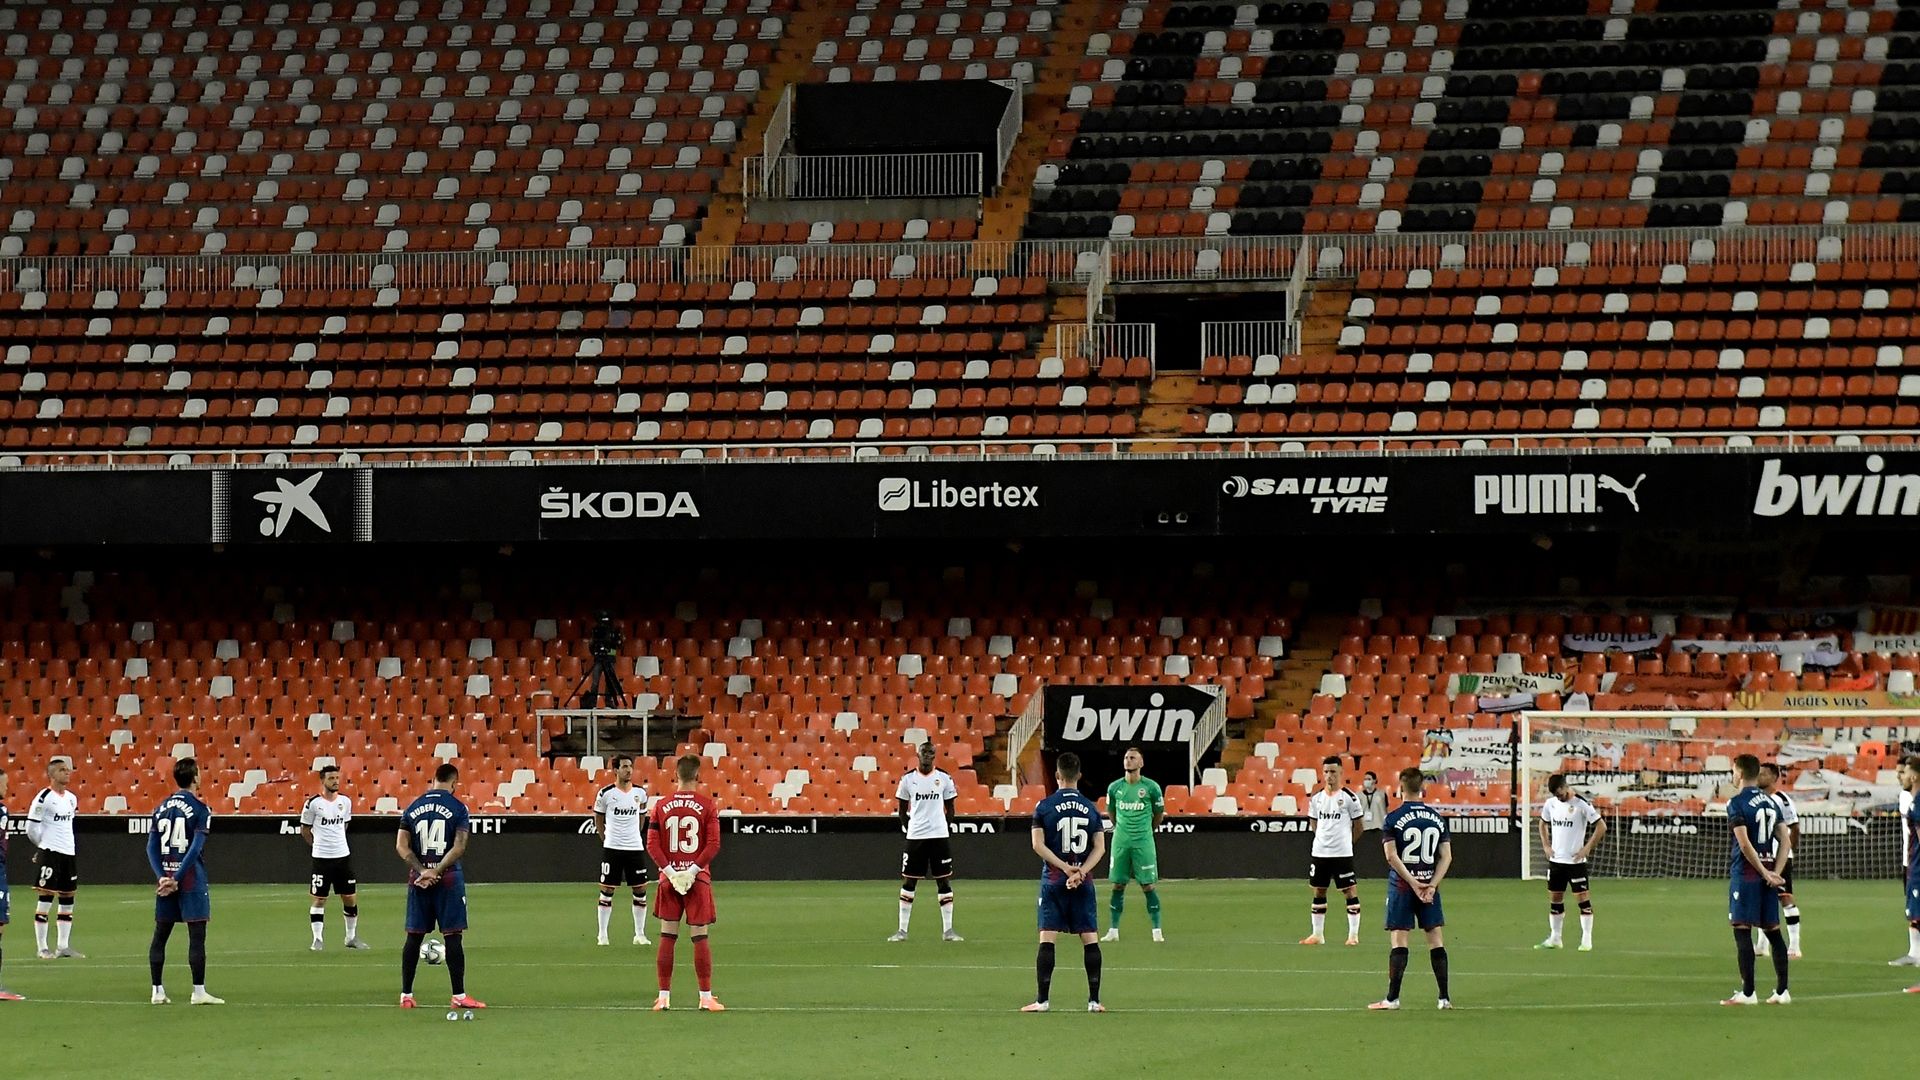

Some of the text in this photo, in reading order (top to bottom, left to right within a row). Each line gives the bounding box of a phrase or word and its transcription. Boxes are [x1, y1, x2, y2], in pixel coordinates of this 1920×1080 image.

[1251, 476, 1388, 495] SAILUN
[1754, 454, 1920, 516] bwin
[914, 479, 1039, 507] Libertex
[1475, 474, 1595, 514] PUMA
[541, 487, 699, 518] ŠKODA
[1311, 497, 1388, 513] TYRE
[1062, 692, 1196, 742] bwin
[915, 791, 940, 800] bwin
[435, 804, 453, 819] VEZO
[614, 807, 637, 815] bwin
[684, 800, 703, 815] FDEZ
[1119, 801, 1145, 810] bwin
[54, 813, 72, 822] bwi
[321, 815, 344, 825] bwin
[1552, 818, 1574, 828] bwin
[158, 817, 189, 855] 24
[415, 819, 447, 856] 14
[665, 815, 699, 854] 13
[1056, 816, 1089, 854] 15
[1402, 826, 1440, 865] 20
[41, 866, 53, 879] 19
[601, 862, 610, 875] 10
[1309, 863, 1316, 877] 3
[312, 874, 323, 887] 25
